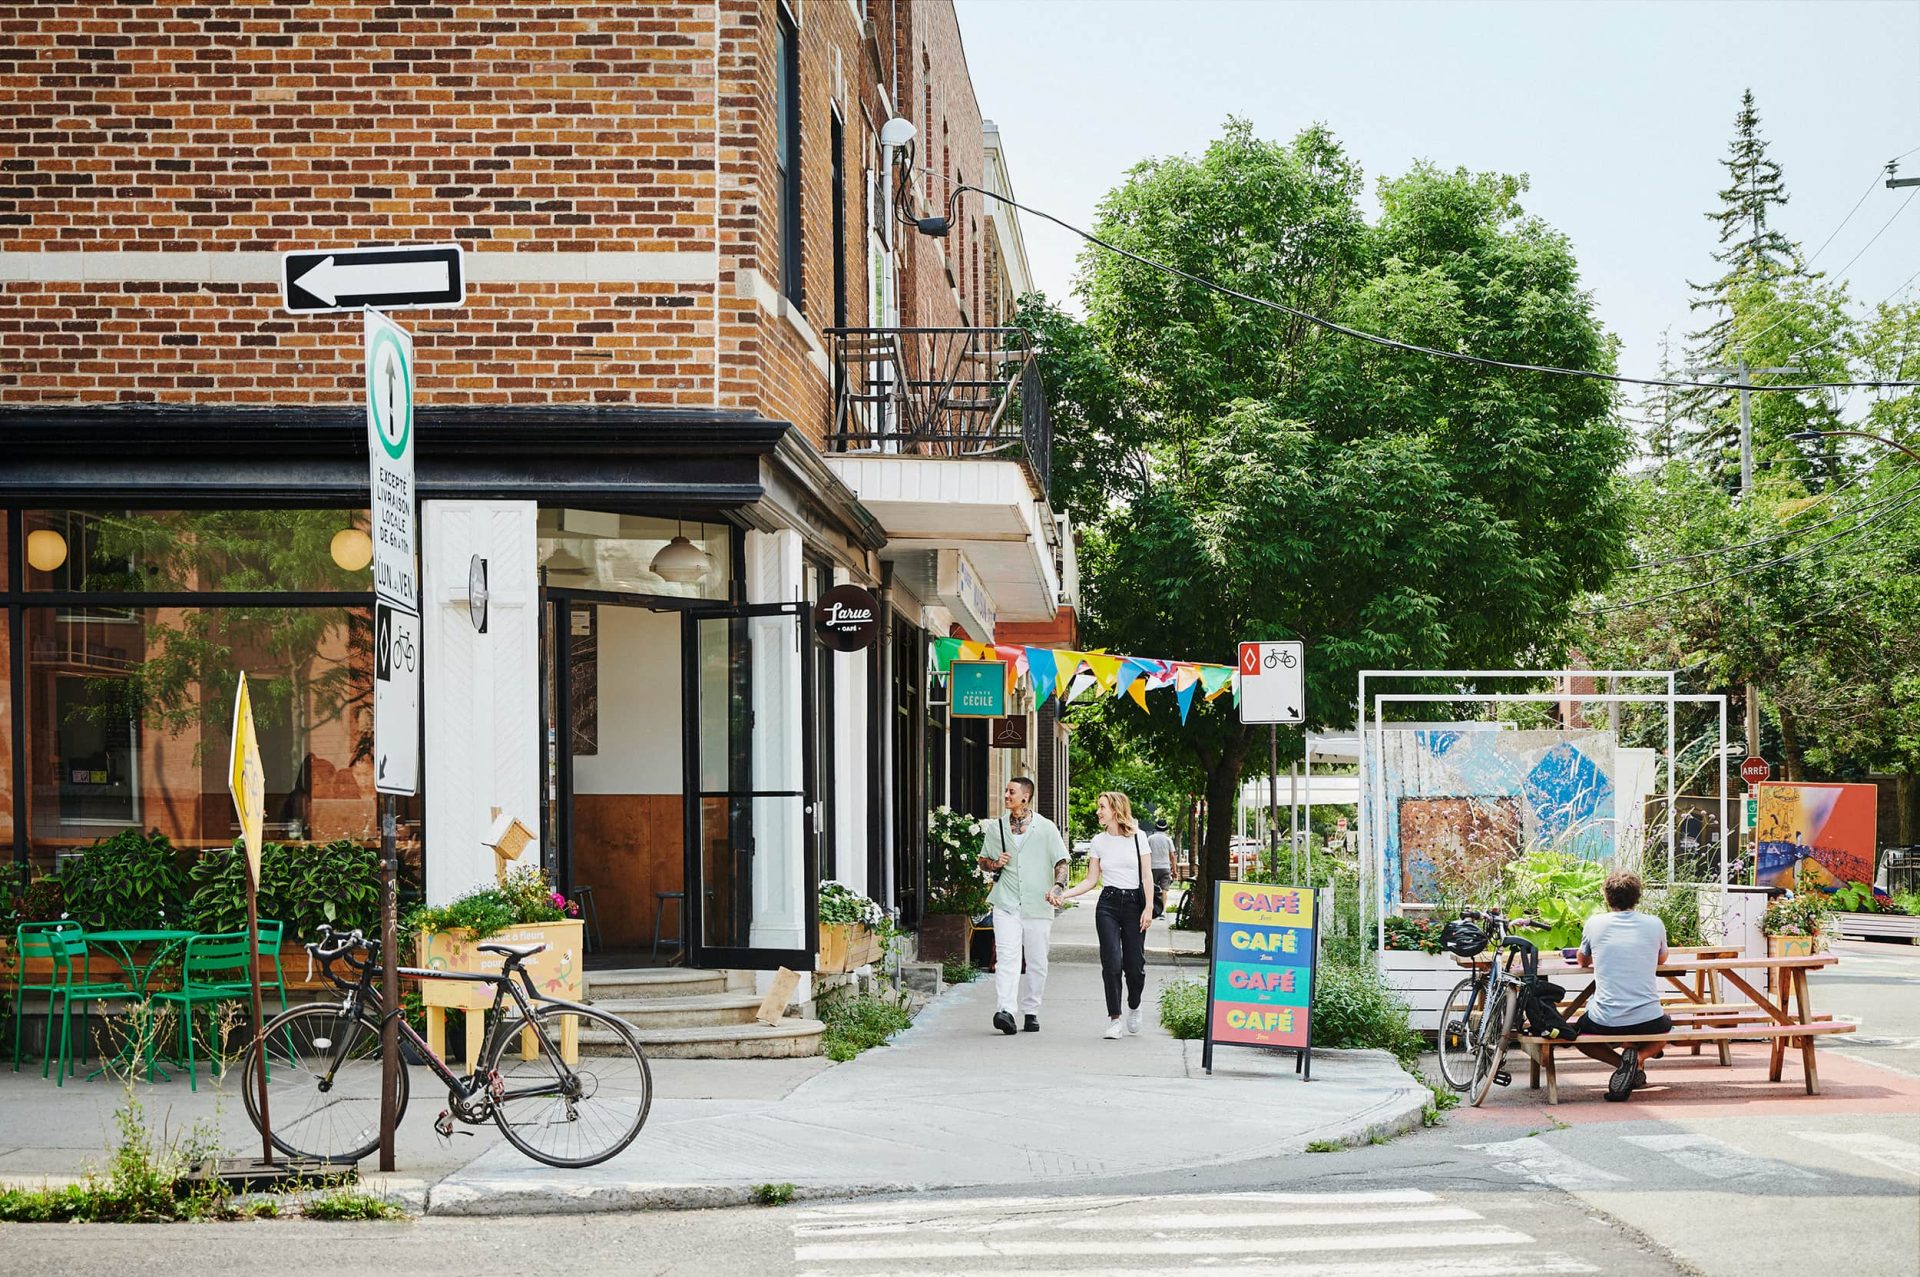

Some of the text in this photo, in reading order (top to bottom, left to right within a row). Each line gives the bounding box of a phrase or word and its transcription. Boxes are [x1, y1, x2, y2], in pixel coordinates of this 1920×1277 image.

[377, 484, 410, 517] LIVRAISON
[382, 507, 406, 534] LOCALE
[380, 526, 388, 544] DE
[823, 602, 873, 626] Larue
[1742, 766, 1768, 776] ARRÊT
[1233, 890, 1300, 915] CAFÉ
[1230, 929, 1298, 954] CAFÉ
[1228, 969, 1296, 994] CAFÉ
[1226, 1008, 1295, 1033] CAFÉ
